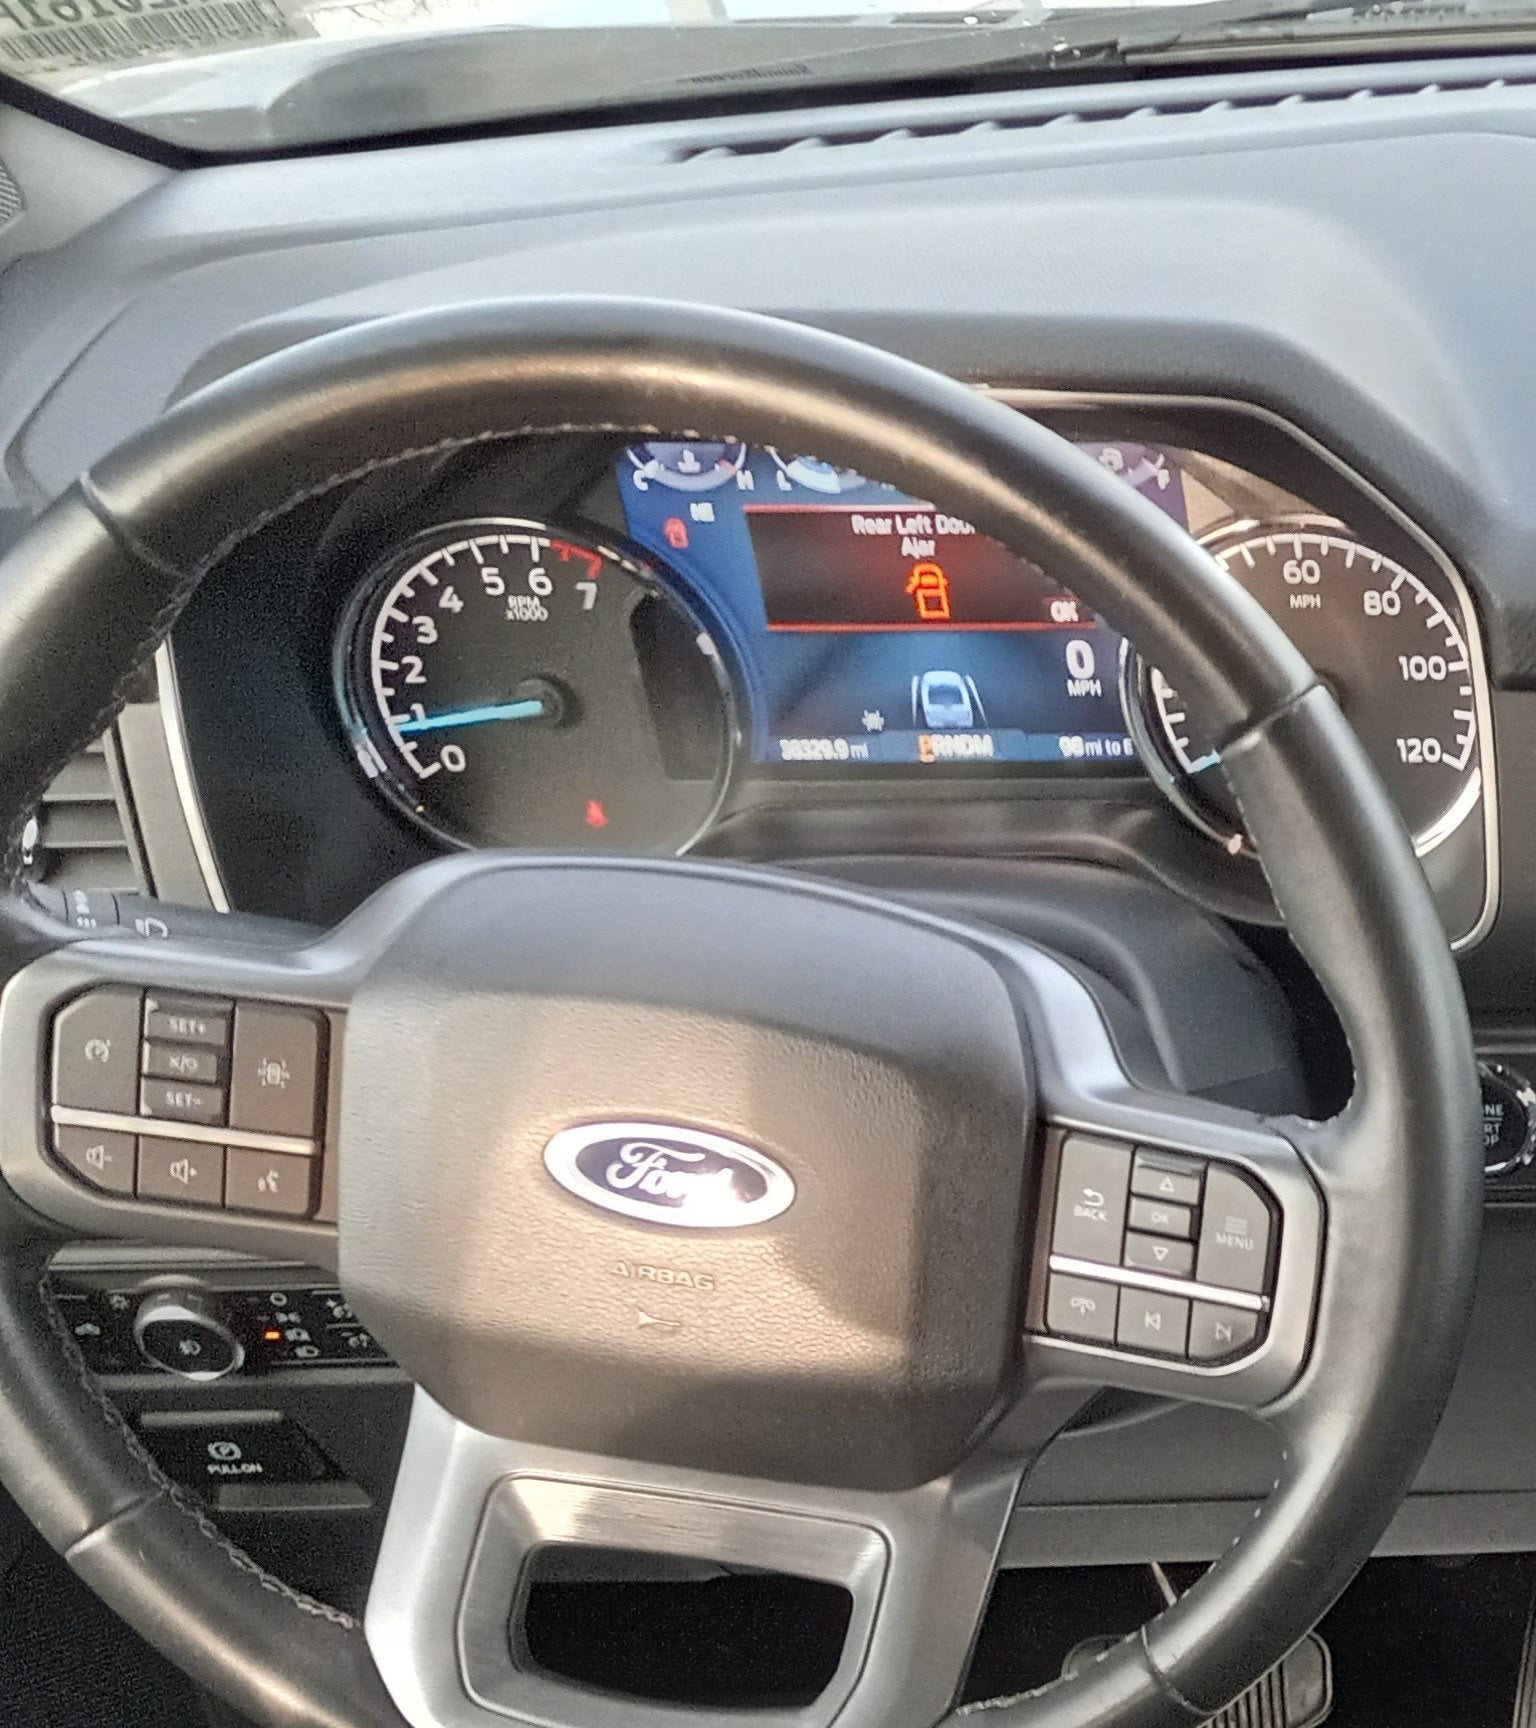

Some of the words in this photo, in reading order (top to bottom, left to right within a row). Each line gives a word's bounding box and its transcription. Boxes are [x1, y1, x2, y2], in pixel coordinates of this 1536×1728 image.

[632, 469, 650, 491] C
[776, 469, 793, 491] L
[850, 514, 893, 536] Rear
[895, 513, 933, 536] Left
[901, 536, 937, 559] Ajar
[481, 567, 506, 597] 5
[528, 567, 554, 597] 6
[1282, 558, 1322, 585] 60
[438, 585, 465, 614] 4
[507, 595, 541, 609] RPM
[574, 581, 599, 611] 7
[1289, 593, 1322, 610] MPH
[1363, 590, 1402, 617] 80
[1049, 600, 1079, 623] OK
[411, 615, 439, 645] 3
[400, 656, 428, 685] 2
[1065, 639, 1095, 680] 0
[1398, 655, 1447, 682] 100
[1066, 678, 1102, 698] MPH
[439, 743, 467, 774] 0
[1084, 737, 1103, 756] mi
[1104, 737, 1122, 757] to
[1396, 737, 1442, 764] 120
[1073, 1205, 1108, 1223] BACK
[1150, 1211, 1170, 1225] OK
[1215, 1232, 1255, 1251] MENU
[611, 1260, 715, 1291] AIRBAG
